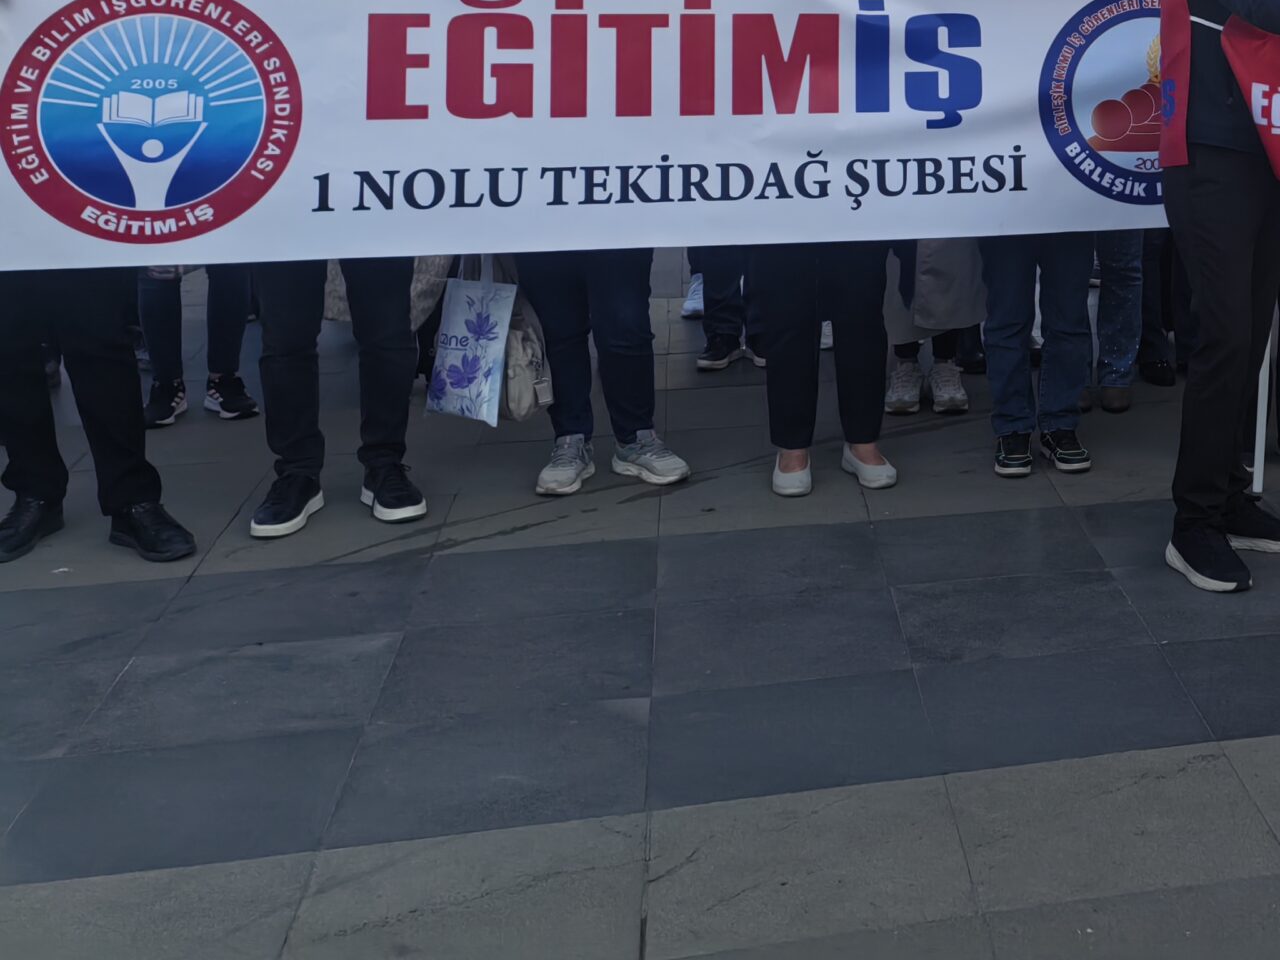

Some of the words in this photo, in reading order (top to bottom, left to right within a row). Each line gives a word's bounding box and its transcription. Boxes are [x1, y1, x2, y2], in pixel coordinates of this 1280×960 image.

[32, 7, 96, 62] BİLİM
[1066, 32, 1086, 47] İŞ
[14, 65, 40, 94] VE
[131, 79, 179, 89] 2005
[1054, 46, 1076, 81] KAMU
[250, 57, 294, 180] SENDİKASI
[1049, 81, 1072, 136] BİRLEŞİK
[6, 103, 50, 185] EĞİTİM
[1135, 157, 1160, 171] 200
[311, 172, 335, 213] 1
[352, 167, 528, 212] NOLU
[540, 150, 832, 206] TEKİRDAĞ
[845, 144, 1029, 211] ŞUBESİ
[1065, 141, 1147, 196] BİRLEŞİK
[80, 203, 215, 236] EĞİTİM-İŞ
